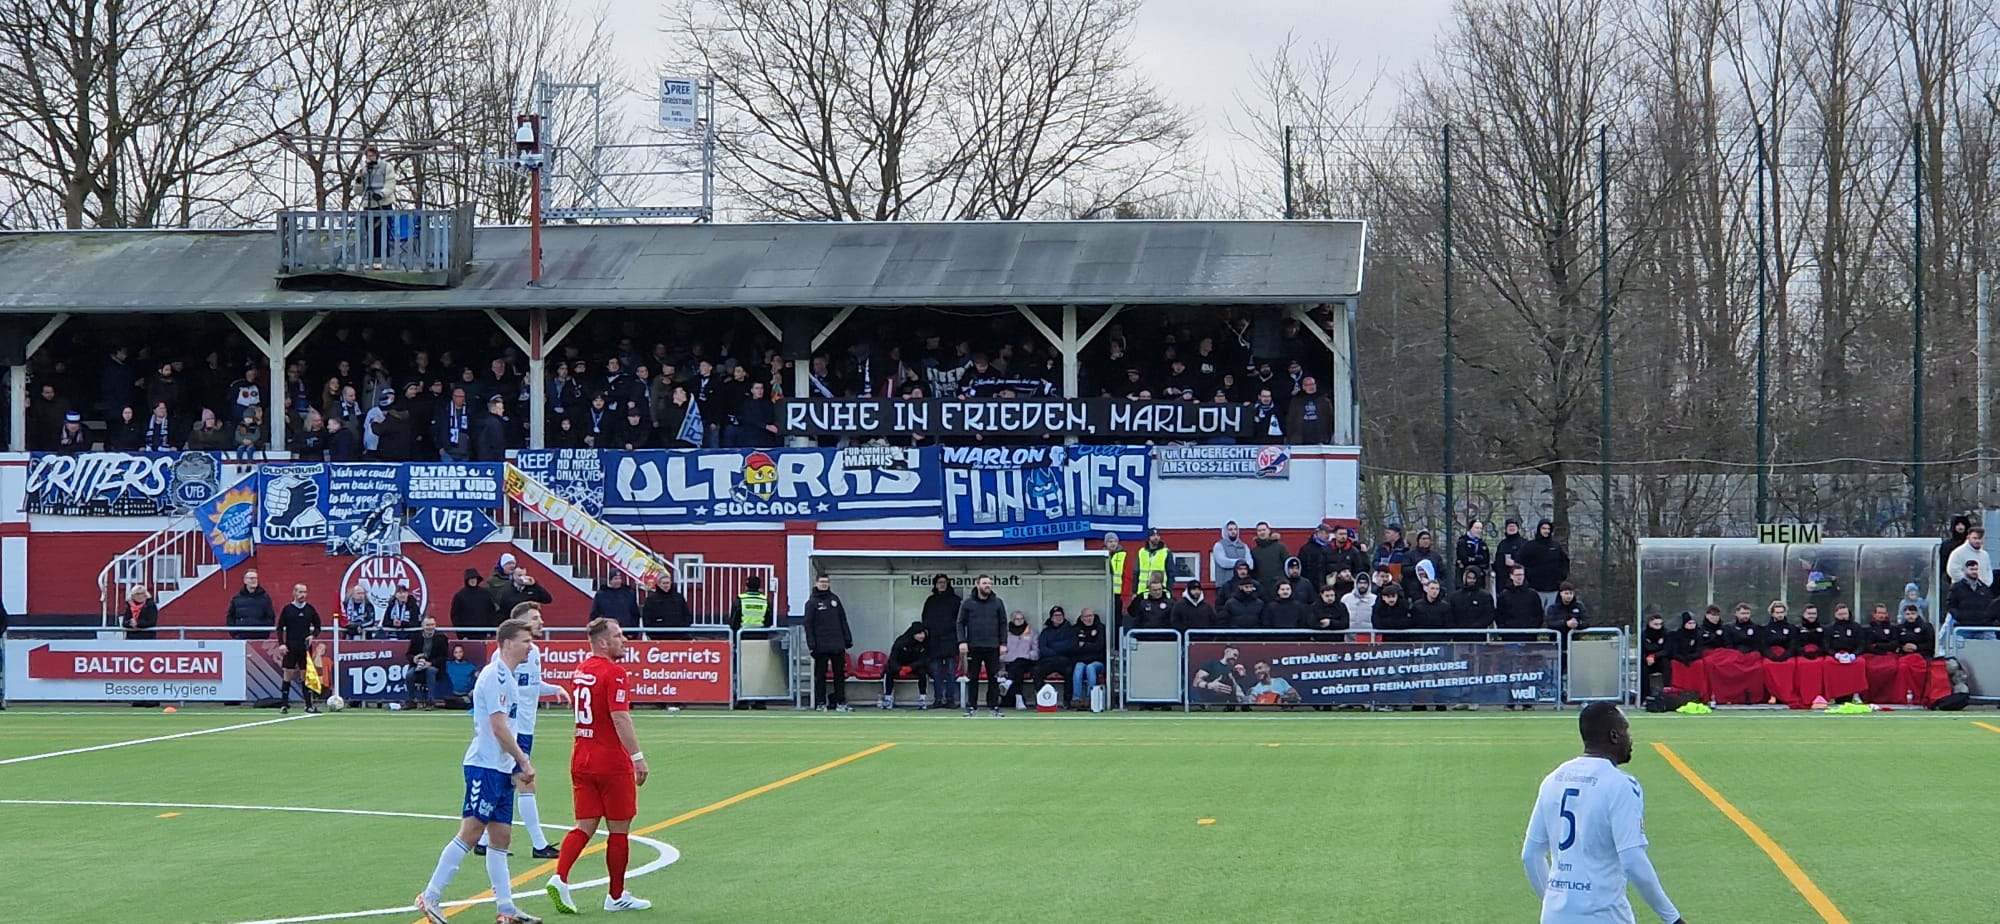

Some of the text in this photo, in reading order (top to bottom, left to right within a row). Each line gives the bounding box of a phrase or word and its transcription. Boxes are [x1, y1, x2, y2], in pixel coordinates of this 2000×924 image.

[663, 80, 691, 95] SPREE
[786, 402, 1241, 434] RUHE IN FRIEDEN, MARLON
[560, 449, 598, 459] NO COPS
[942, 446, 1046, 465] MARLON
[1181, 447, 1257, 459] FANGERECHTE
[517, 453, 553, 468] KEEP
[557, 459, 600, 470] NO NAZIS
[844, 454, 893, 467] MATHIS
[1162, 461, 1257, 473] ANSTOSSZEITEN
[263, 465, 322, 473] OLDENBURG
[368, 467, 396, 478] could
[409, 465, 467, 477] ULTRAS
[556, 470, 580, 480] ONLY
[27, 453, 173, 504] CRITTERS
[351, 480, 374, 490] back
[409, 479, 497, 492] SEHEN UND
[329, 492, 379, 506] to the good
[409, 491, 496, 500] GESEHEN WERDEN
[713, 502, 811, 516] SUCCADE
[431, 507, 473, 533] VfB
[265, 525, 326, 538] UNITE
[522, 482, 648, 578] OLDENBURG
[1760, 524, 1819, 543] HEIM
[432, 537, 467, 548] ULTRAS
[360, 557, 408, 578] KILIA
[338, 651, 392, 661] FITNESS AB
[647, 647, 720, 664] Gerriets
[1354, 647, 1440, 661] SOLARIUM-FLAT
[74, 656, 218, 673] BALTIC CLEAN
[1301, 669, 1359, 680] EXKLUSIVE
[1361, 667, 1385, 676] LIVE
[1398, 661, 1468, 674] CYBERKURSE
[643, 669, 718, 683] Badsanierung
[1372, 676, 1482, 692] FREIHANTELBEREICH
[1485, 675, 1507, 684] DER
[1509, 672, 1544, 682] STADT
[105, 683, 217, 698] Bessere Hygiene
[573, 686, 593, 724] 13
[1559, 788, 1580, 851] 5
